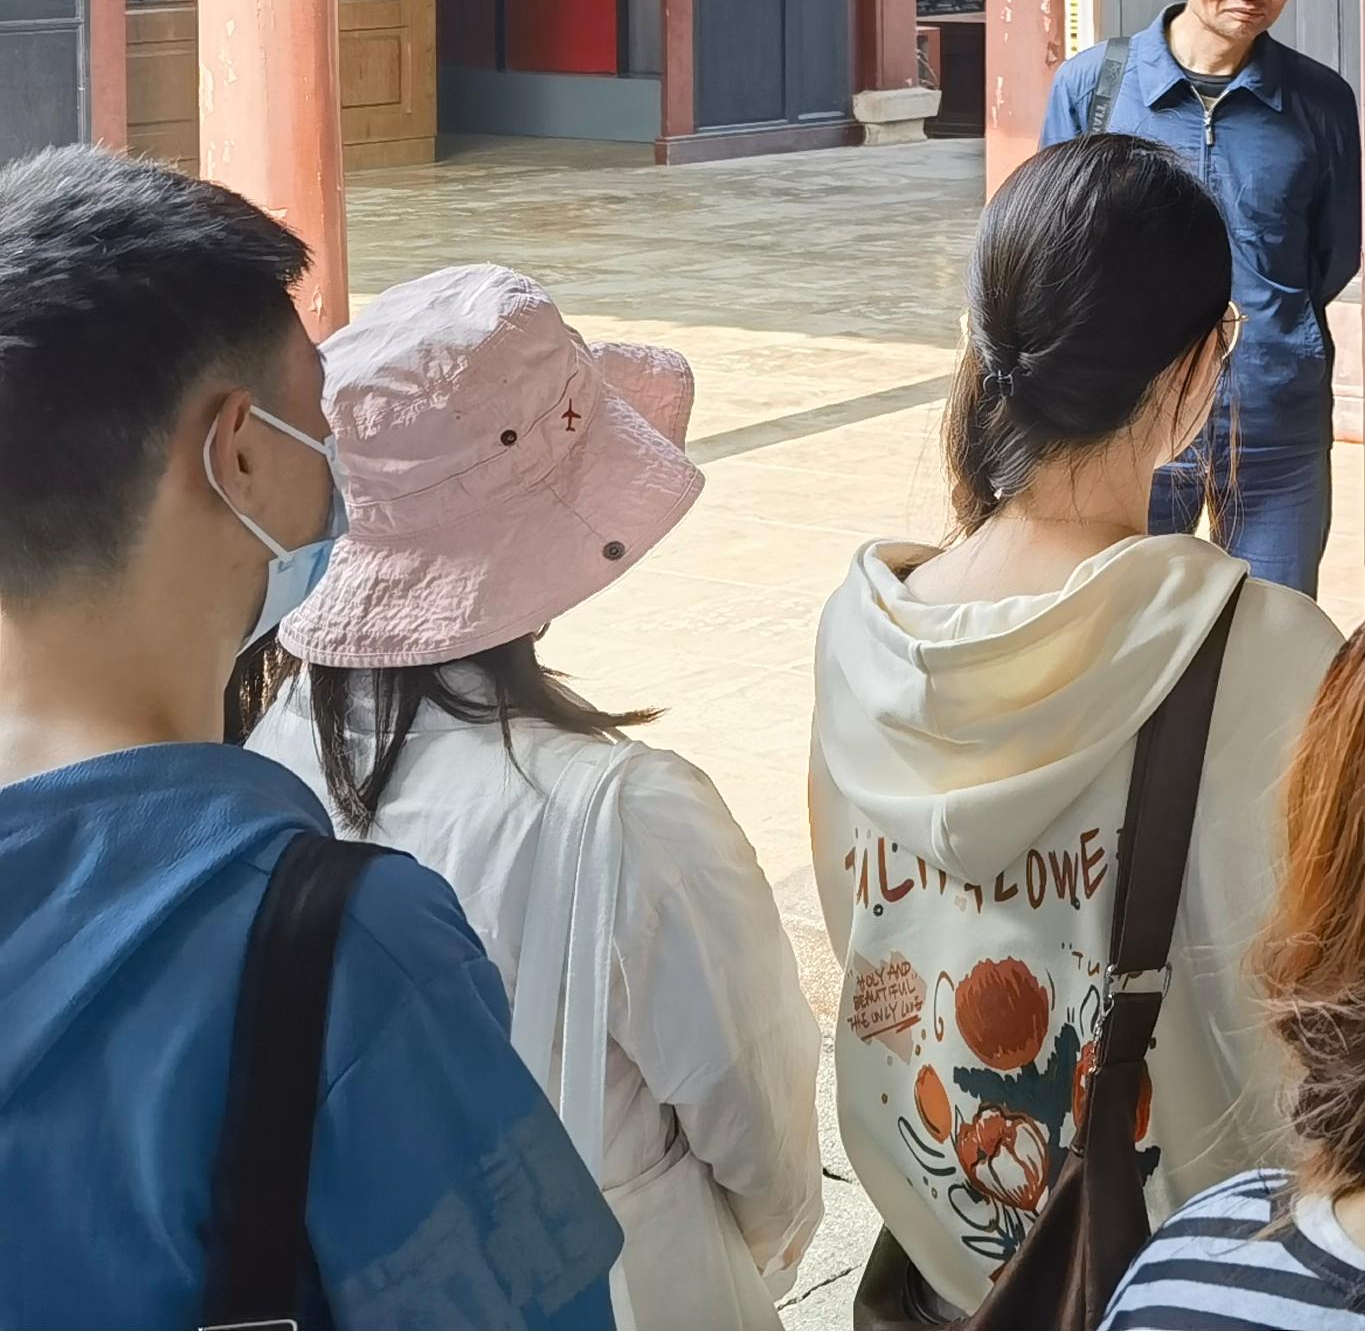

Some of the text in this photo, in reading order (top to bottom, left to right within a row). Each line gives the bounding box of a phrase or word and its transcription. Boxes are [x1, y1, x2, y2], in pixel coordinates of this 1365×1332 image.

[857, 961, 911, 991] HOLY AND
[853, 978, 916, 1011] BEAUTIFUL
